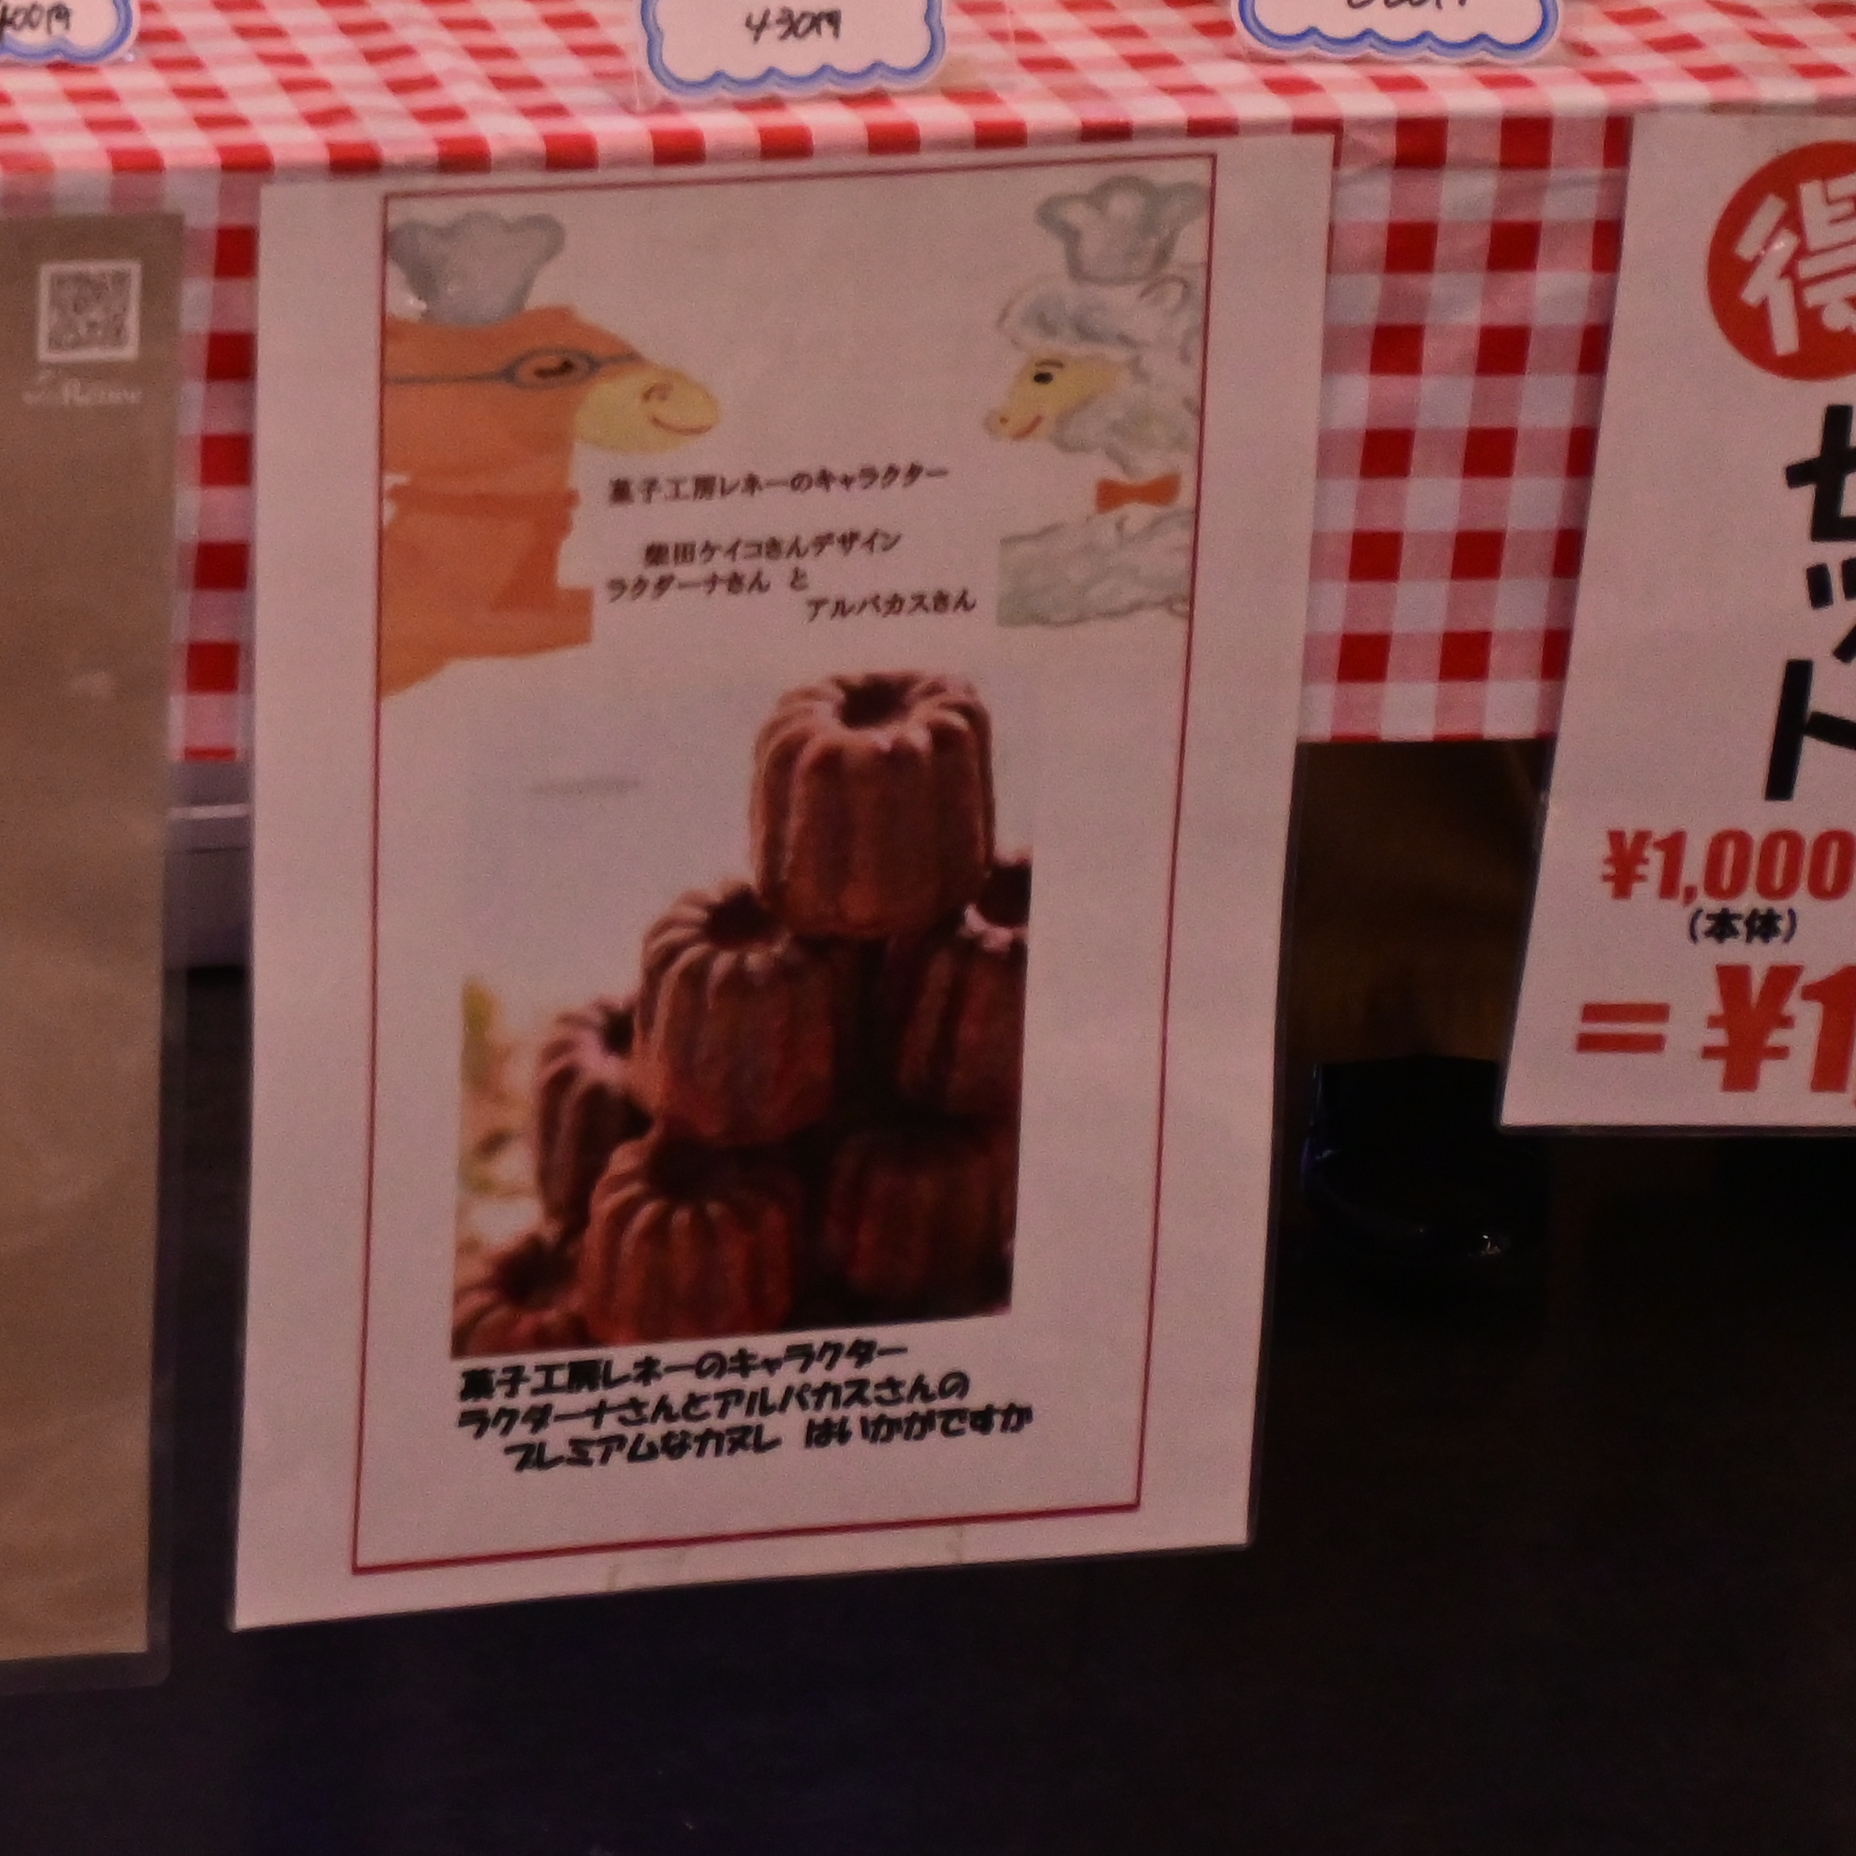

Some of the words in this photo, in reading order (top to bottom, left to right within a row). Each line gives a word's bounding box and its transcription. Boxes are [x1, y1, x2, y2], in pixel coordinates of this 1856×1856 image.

[608, 461, 950, 508] 菓子工房レネーのキャラクター
[1601, 828, 1856, 908] ¥1,000
[1689, 907, 1799, 946] (本体)
[458, 1338, 909, 1403] 菓子工房レネーのキャラクター
[457, 1369, 972, 1441] ラクダーナさんとアルパカスさんの
[803, 1402, 1035, 1449] はいかがですか
